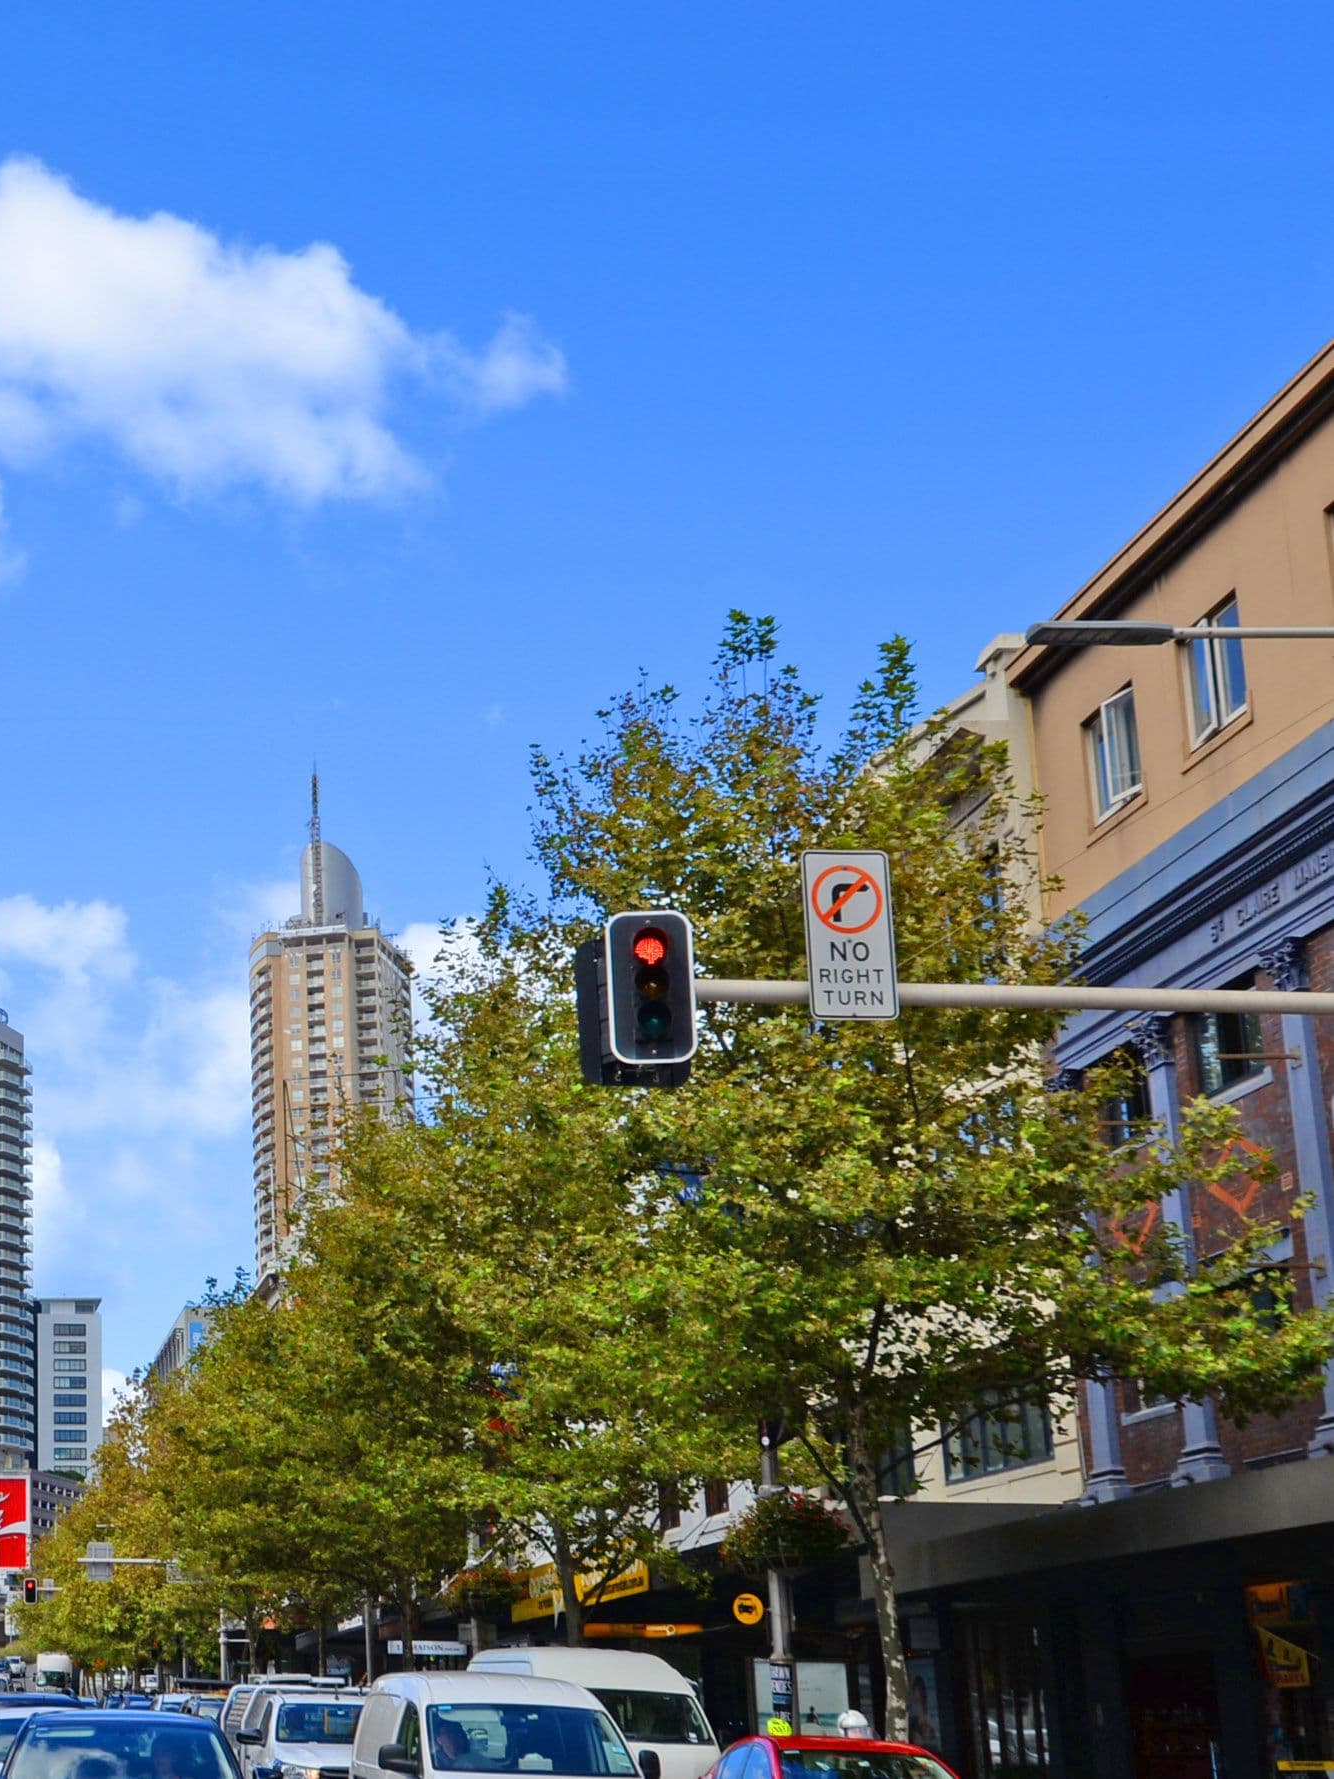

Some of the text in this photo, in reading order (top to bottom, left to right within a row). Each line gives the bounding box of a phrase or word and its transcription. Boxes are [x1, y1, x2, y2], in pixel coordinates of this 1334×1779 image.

[830, 941, 870, 962] NO
[819, 968, 884, 984] RIGHT
[823, 990, 884, 1006] TURN
